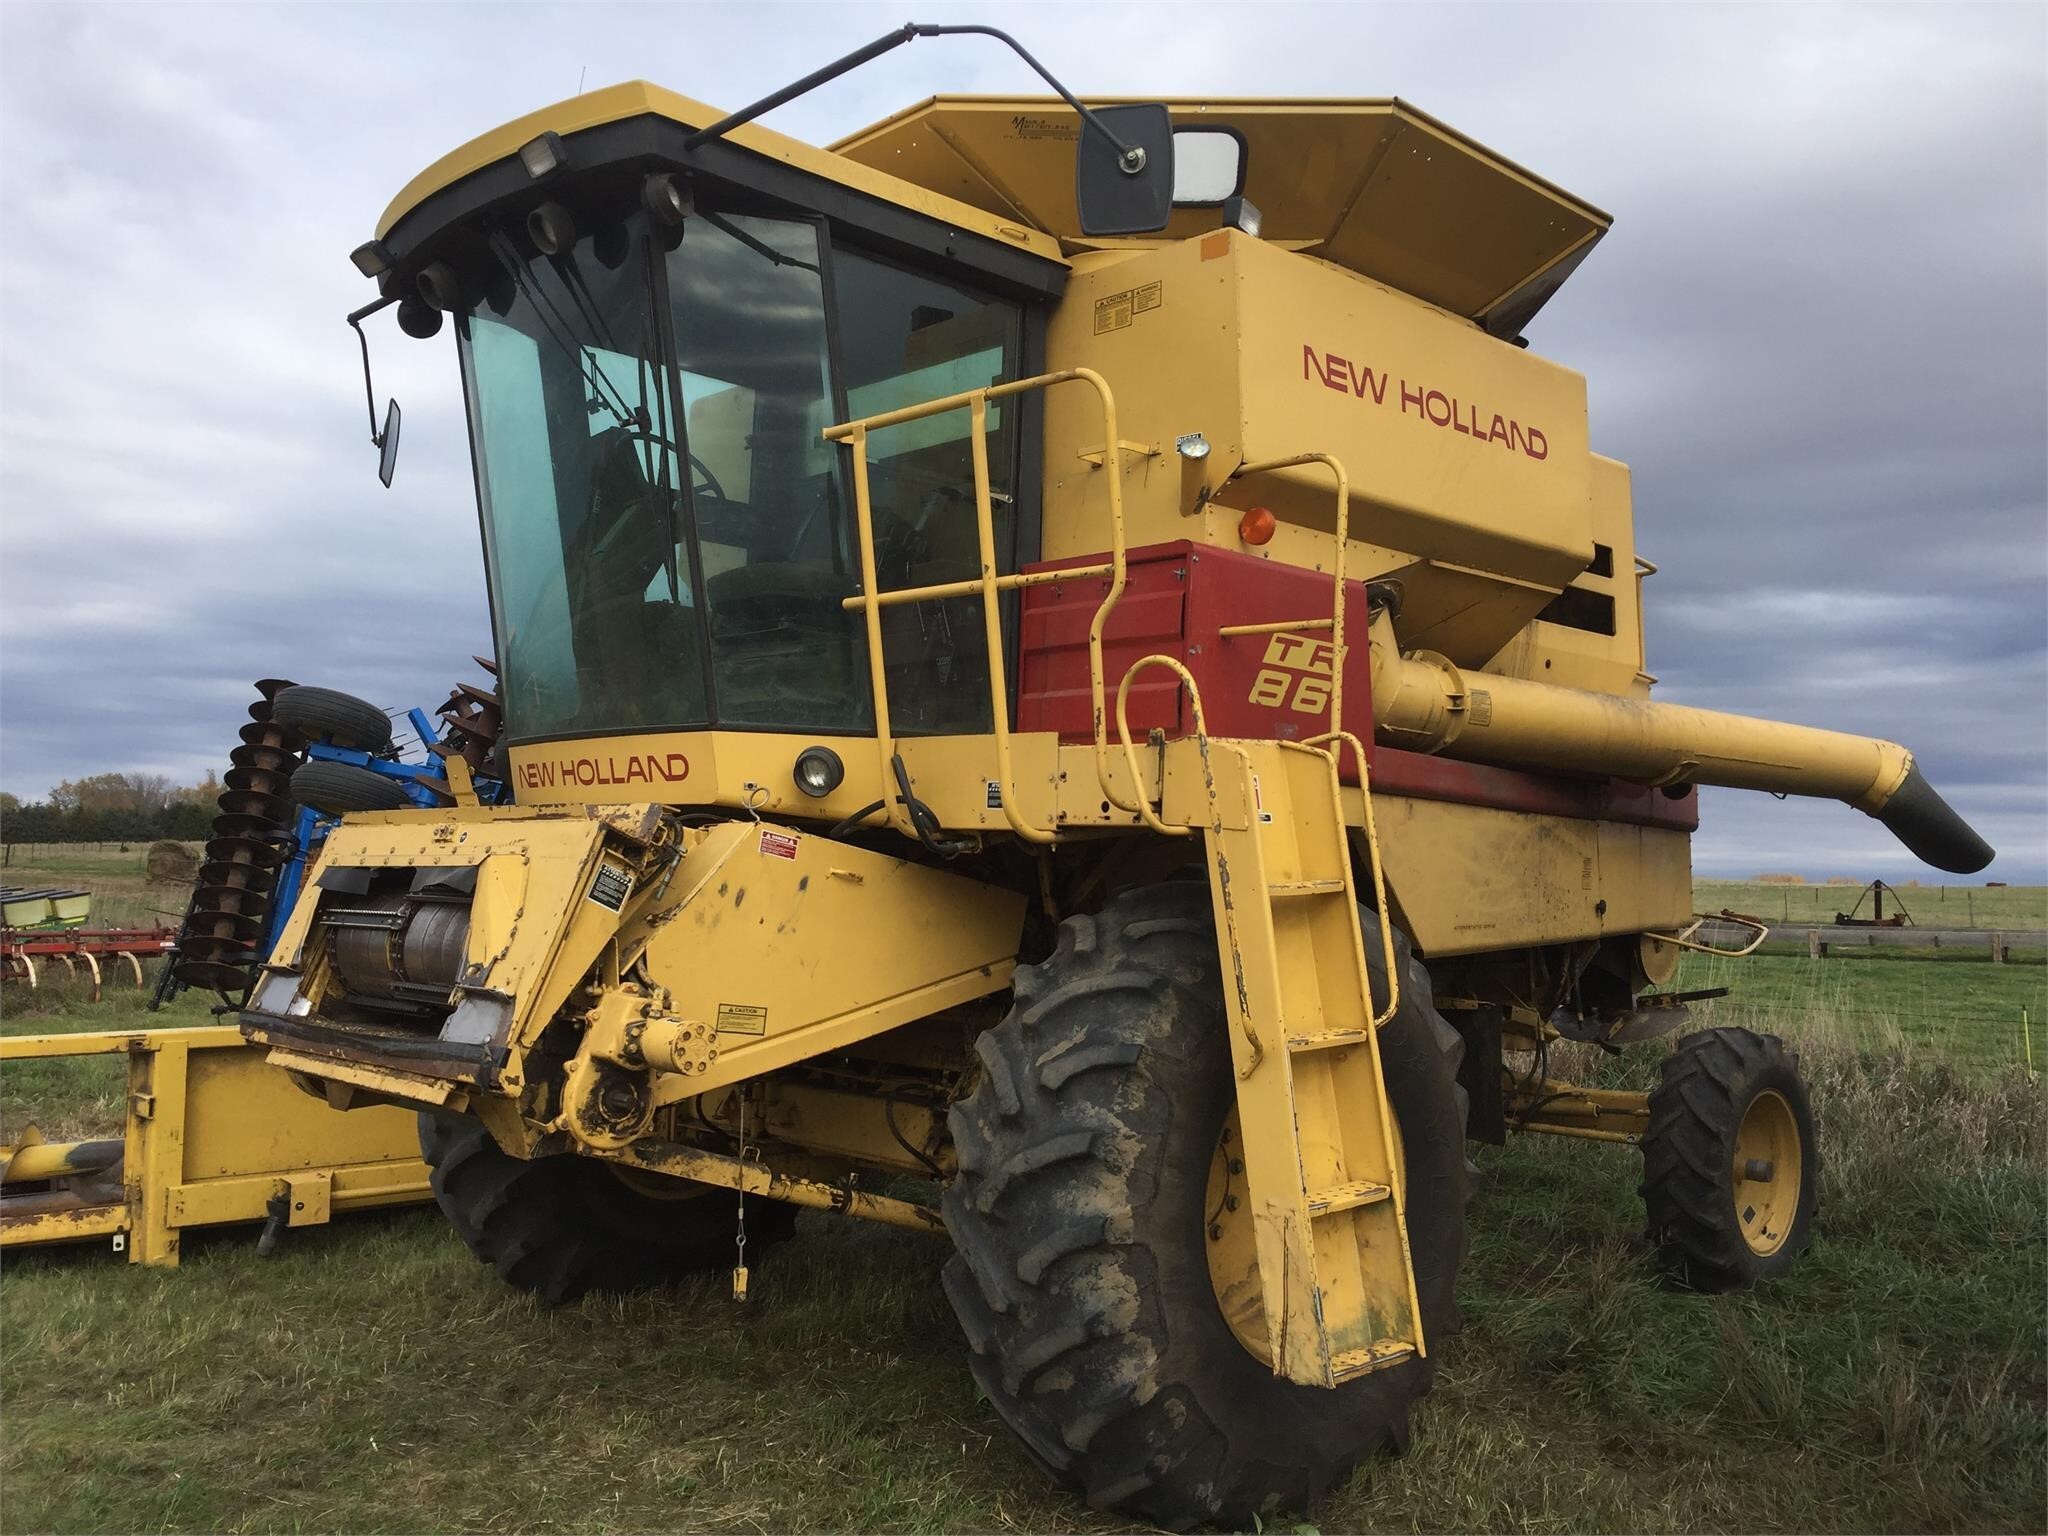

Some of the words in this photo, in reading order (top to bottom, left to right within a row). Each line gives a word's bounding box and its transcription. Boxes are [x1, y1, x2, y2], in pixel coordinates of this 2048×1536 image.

[1303, 344, 1388, 405] NEW
[1400, 379, 1548, 461] HOLLAND
[1248, 669, 1333, 715] 86
[518, 760, 555, 789] NEW
[560, 753, 690, 786] HOLLAND
